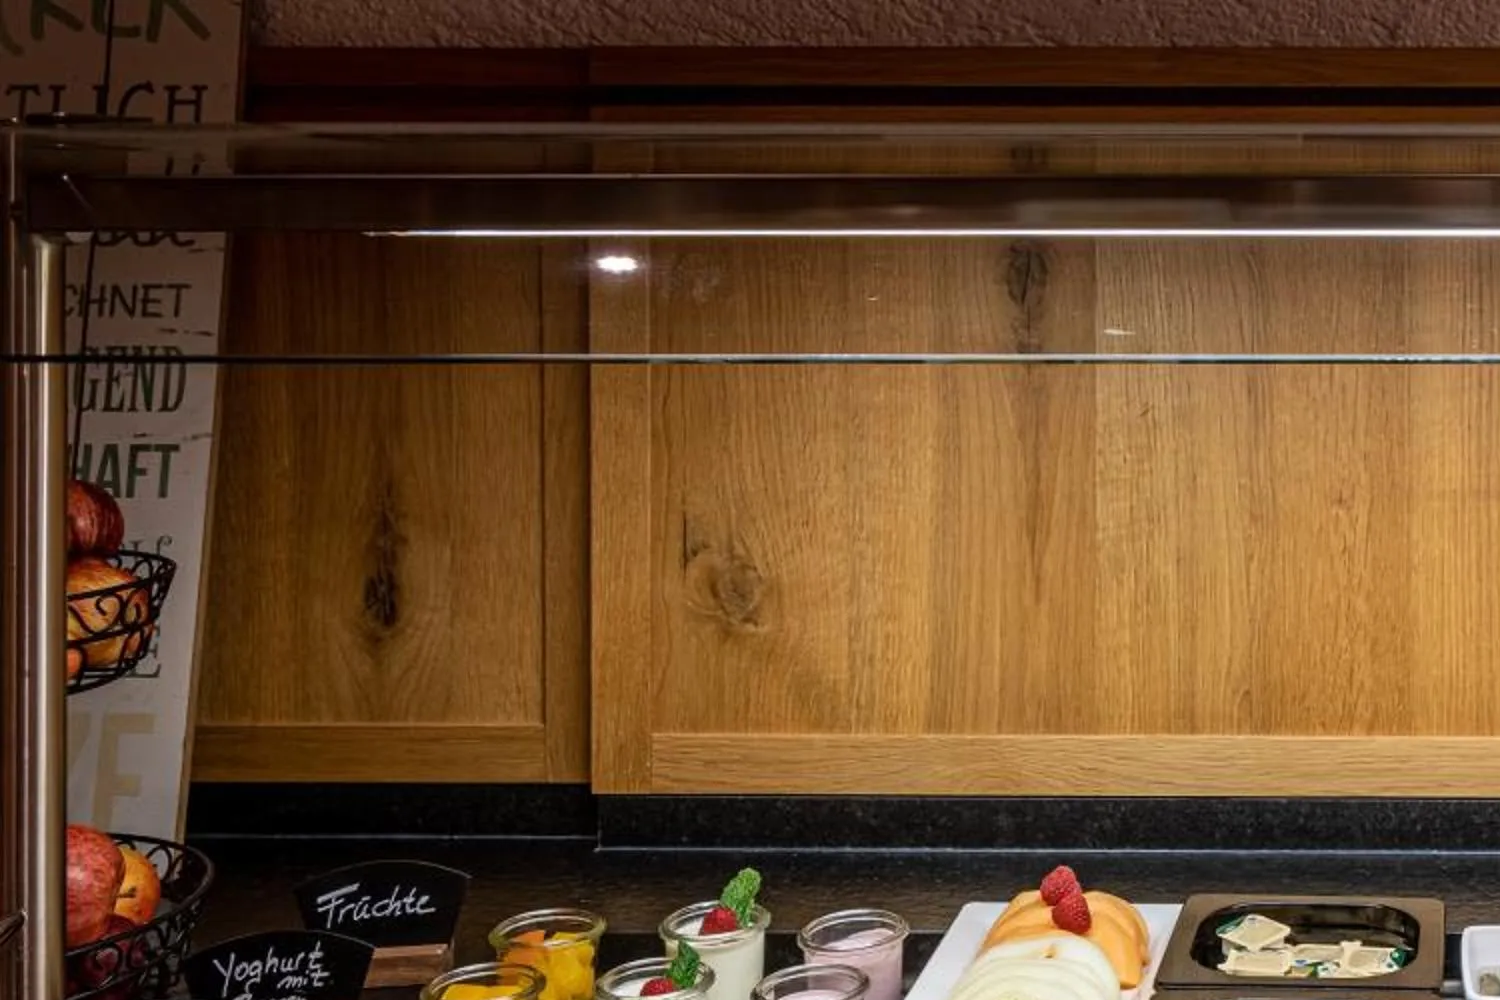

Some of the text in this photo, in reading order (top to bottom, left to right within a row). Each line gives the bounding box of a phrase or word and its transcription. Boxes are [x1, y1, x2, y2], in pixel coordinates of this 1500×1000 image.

[73, 345, 187, 413] GEND
[212, 940, 325, 998] Yoghurt
[276, 969, 331, 990] mit
